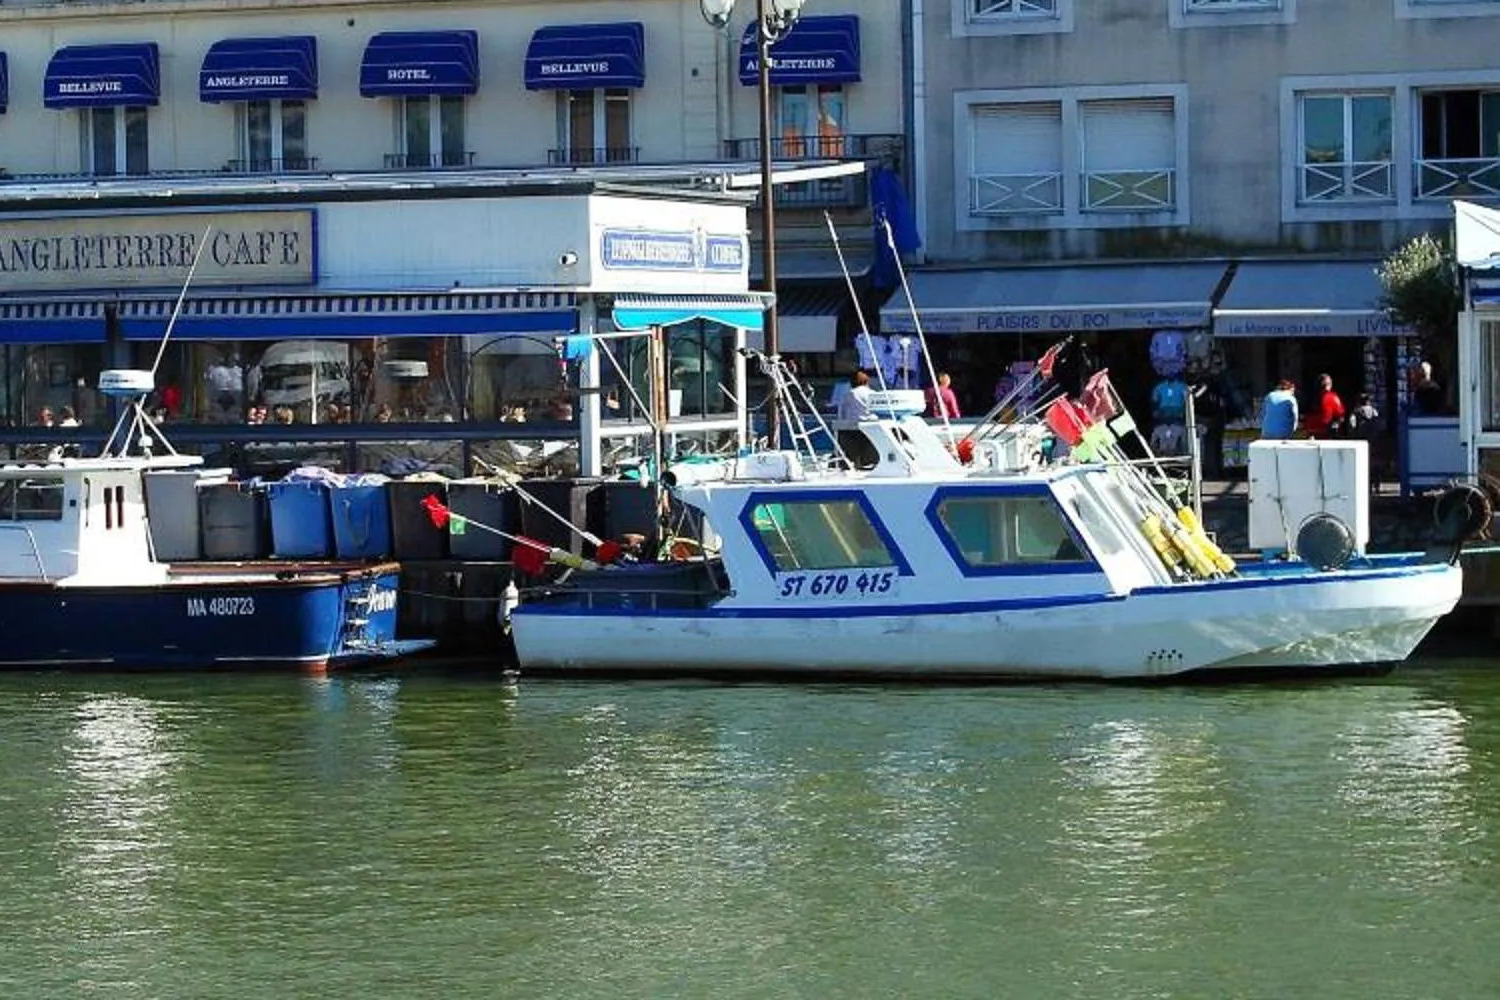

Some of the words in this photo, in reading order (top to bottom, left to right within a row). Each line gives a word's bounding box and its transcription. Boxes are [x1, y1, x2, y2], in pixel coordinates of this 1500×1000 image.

[541, 62, 609, 75] BELLEVUE
[746, 58, 835, 71] ALETERRE
[206, 75, 288, 88] ANGLETERRE
[387, 69, 430, 81] HOTEL
[59, 82, 121, 93] BELLEVUE
[211, 230, 300, 266] CAFE
[1050, 313, 1072, 329] DU
[781, 576, 806, 597] ST
[811, 574, 849, 595] 670
[856, 572, 893, 594] 415
[187, 598, 207, 617] MA
[209, 596, 255, 616] 480723
